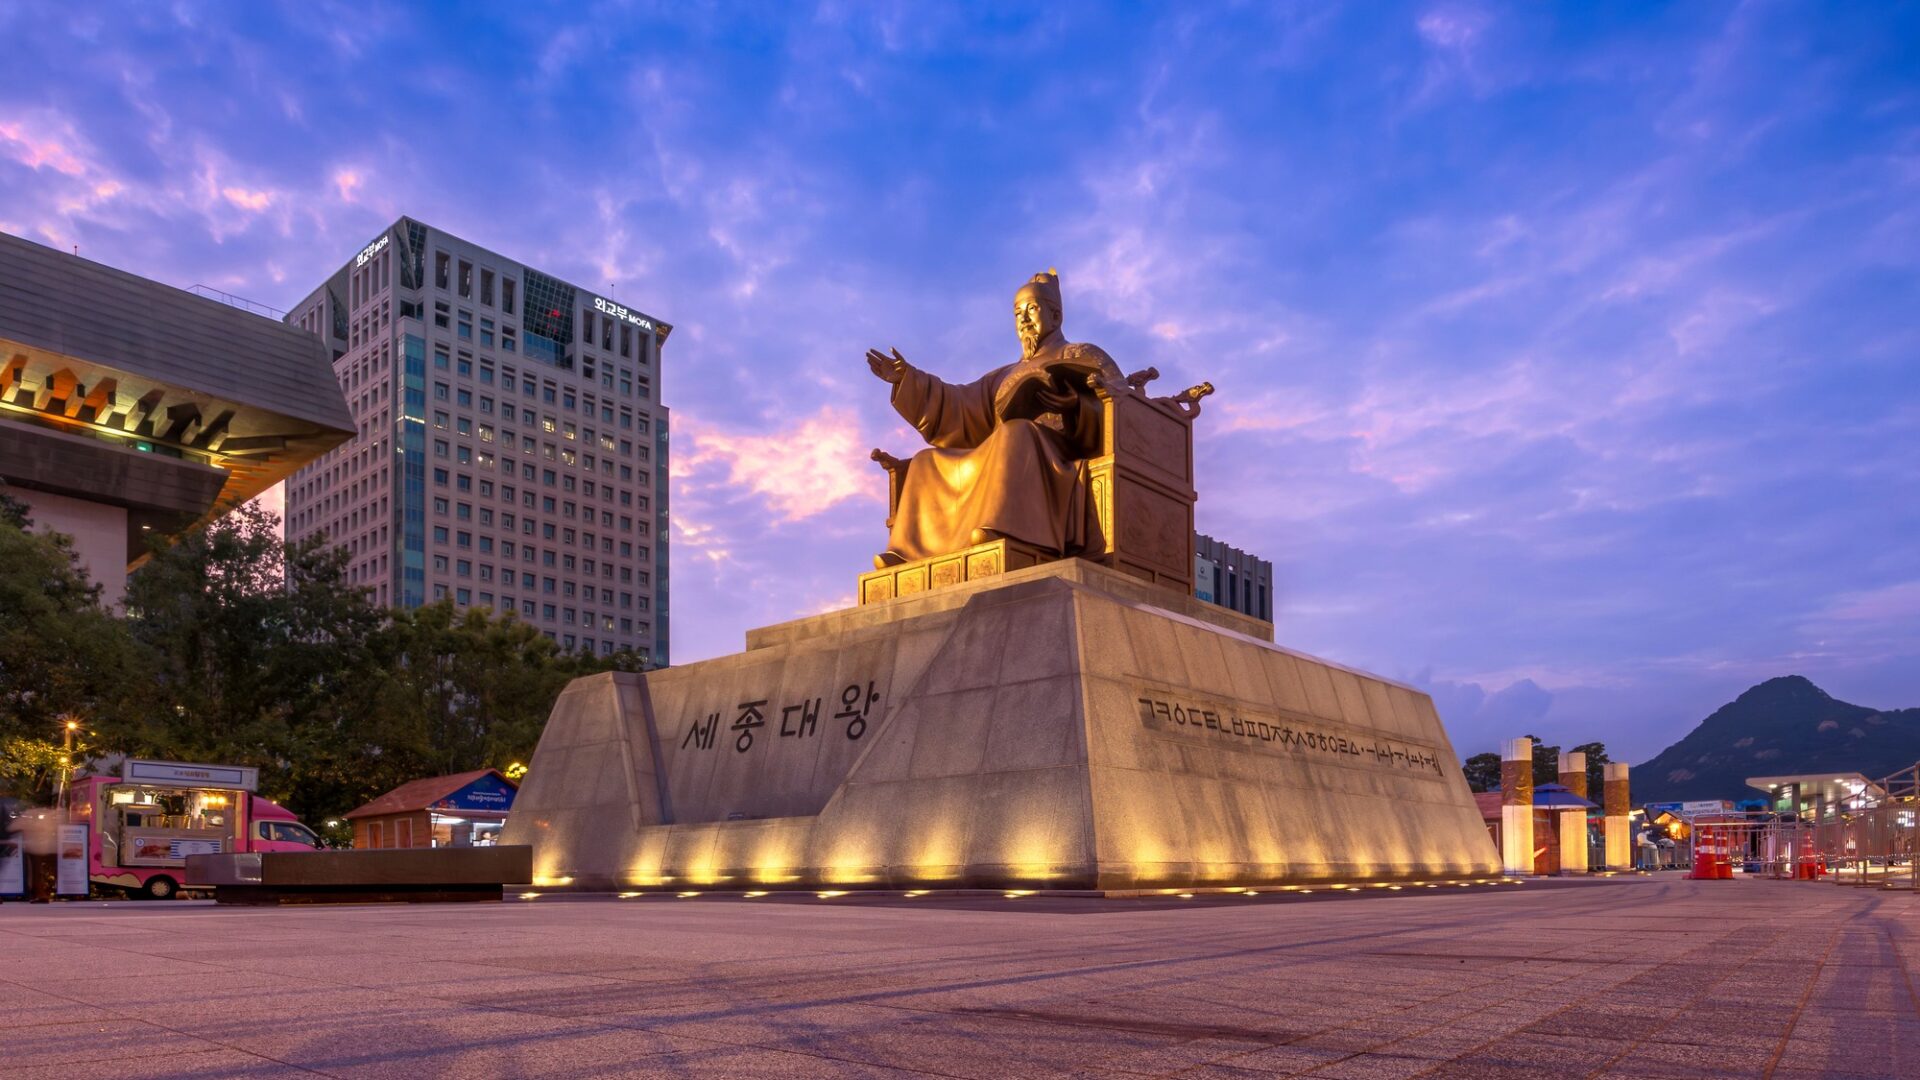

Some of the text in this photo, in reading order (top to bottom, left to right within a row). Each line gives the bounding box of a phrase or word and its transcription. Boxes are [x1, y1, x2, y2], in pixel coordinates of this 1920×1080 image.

[356, 242, 375, 267] 외교부
[594, 297, 652, 330] 외교부 MOFA
[681, 681, 880, 753] 세종대왕
